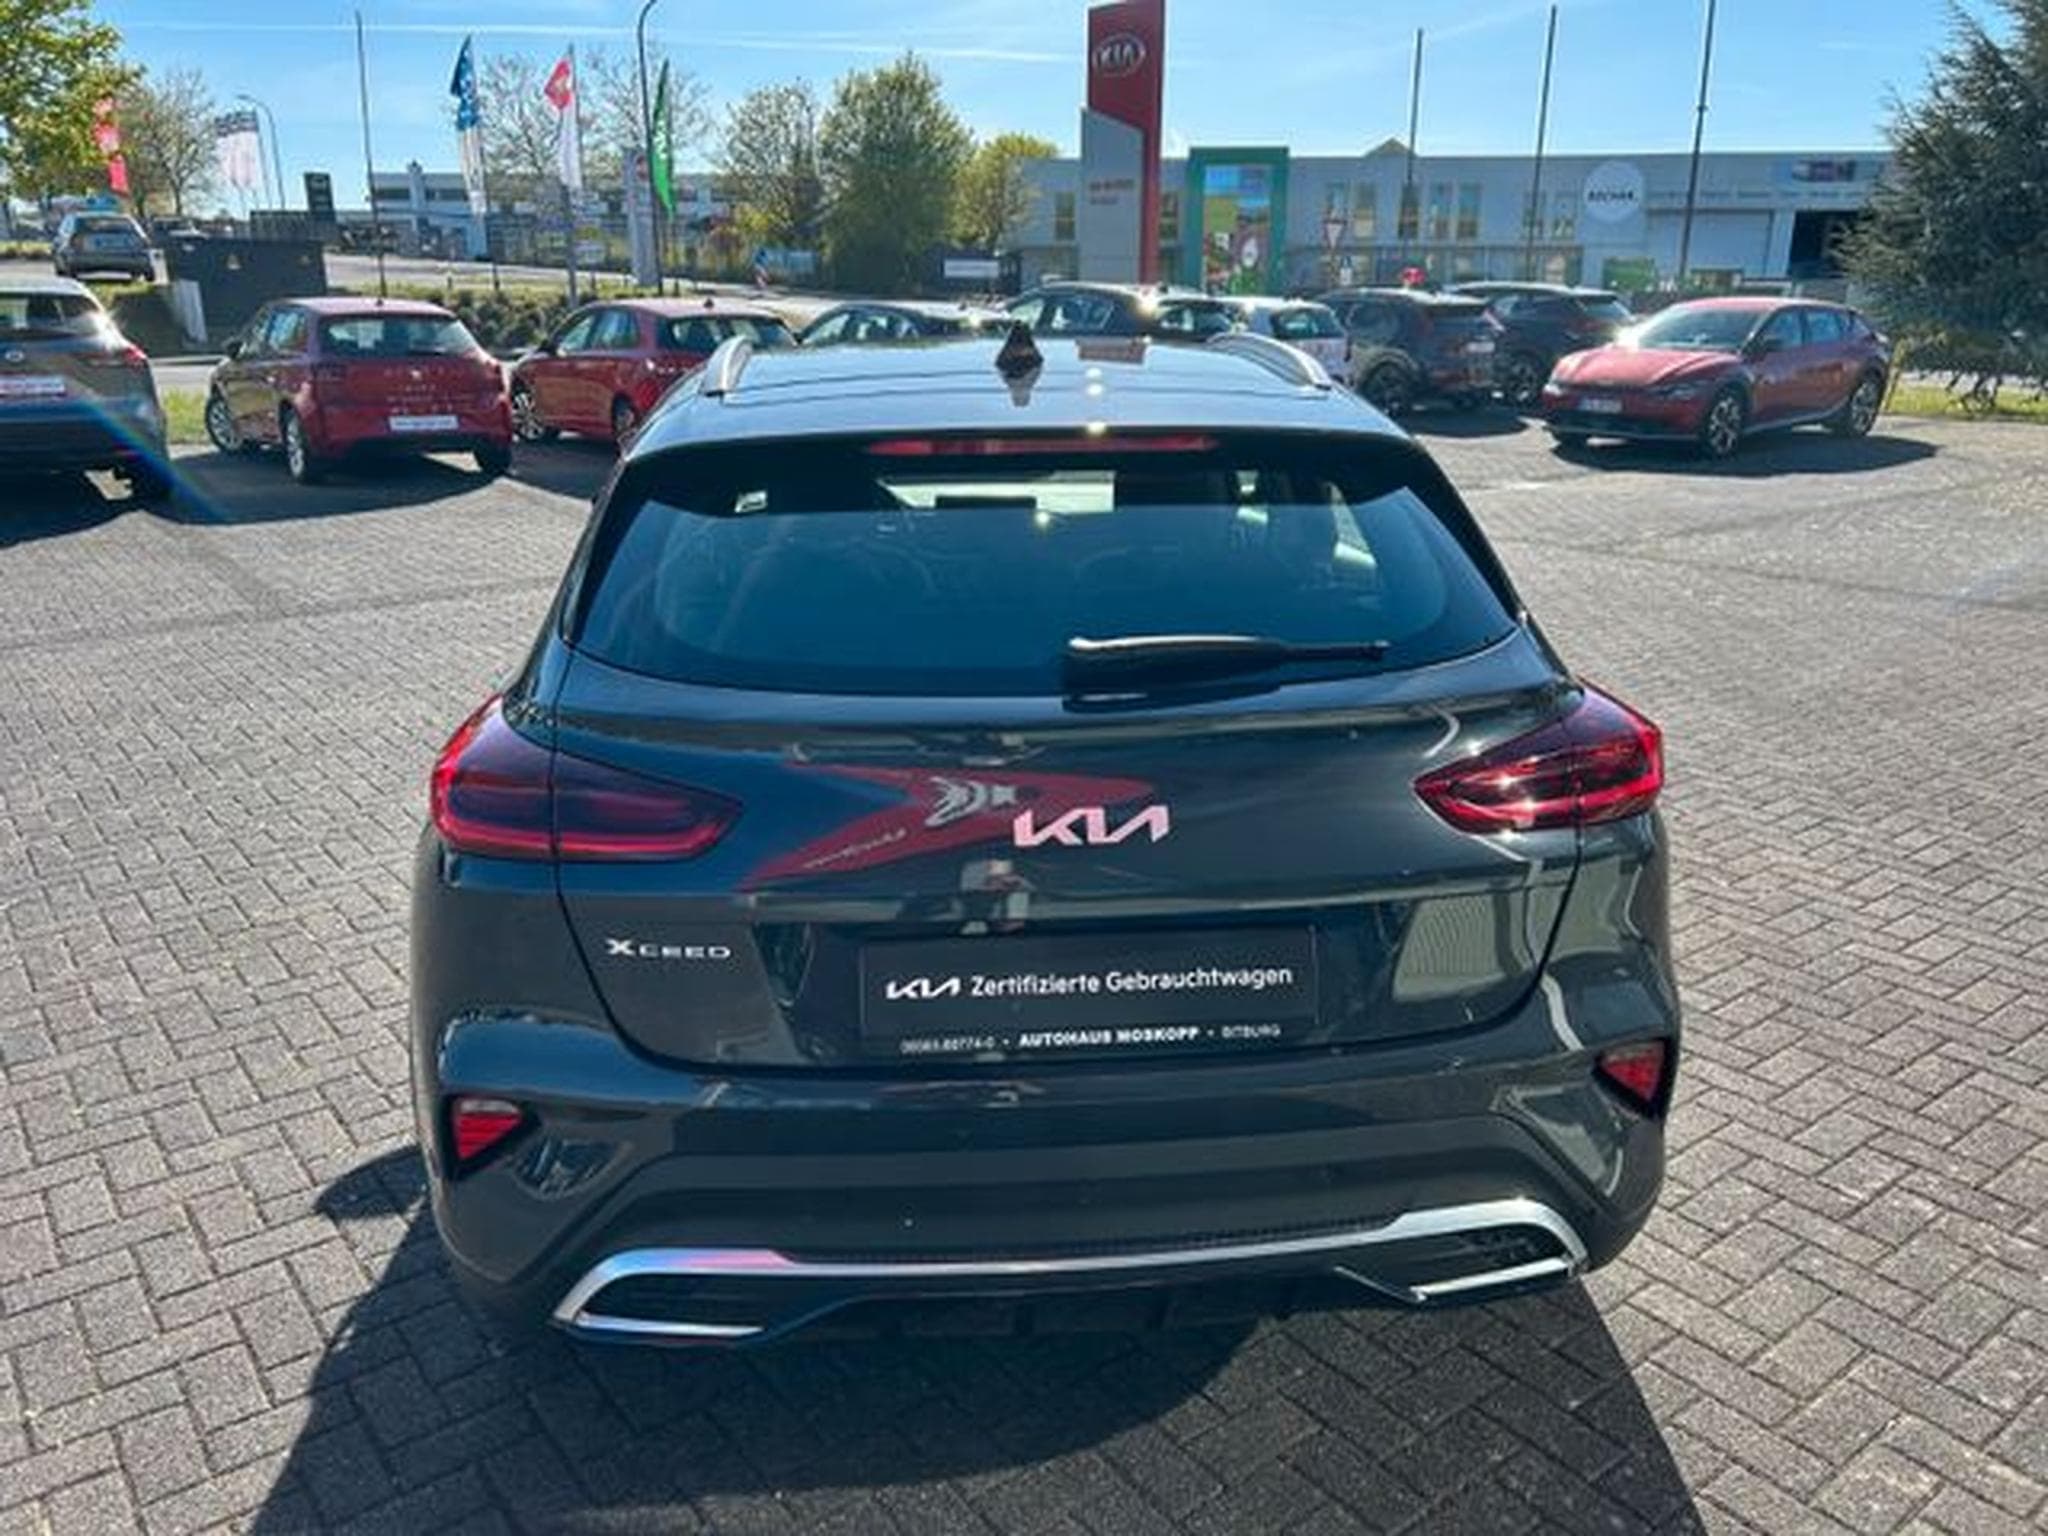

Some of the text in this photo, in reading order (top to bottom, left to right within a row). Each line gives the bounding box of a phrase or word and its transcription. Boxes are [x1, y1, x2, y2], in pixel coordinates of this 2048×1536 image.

[1099, 43, 1136, 67] KIA
[1013, 805, 1169, 848] KIA
[886, 966, 1293, 999] KIA Zertifizierte Gebrauchtwagen
[1018, 1030, 1112, 1048] AUTOHAUS
[1116, 1026, 1199, 1044] MOSKOPP
